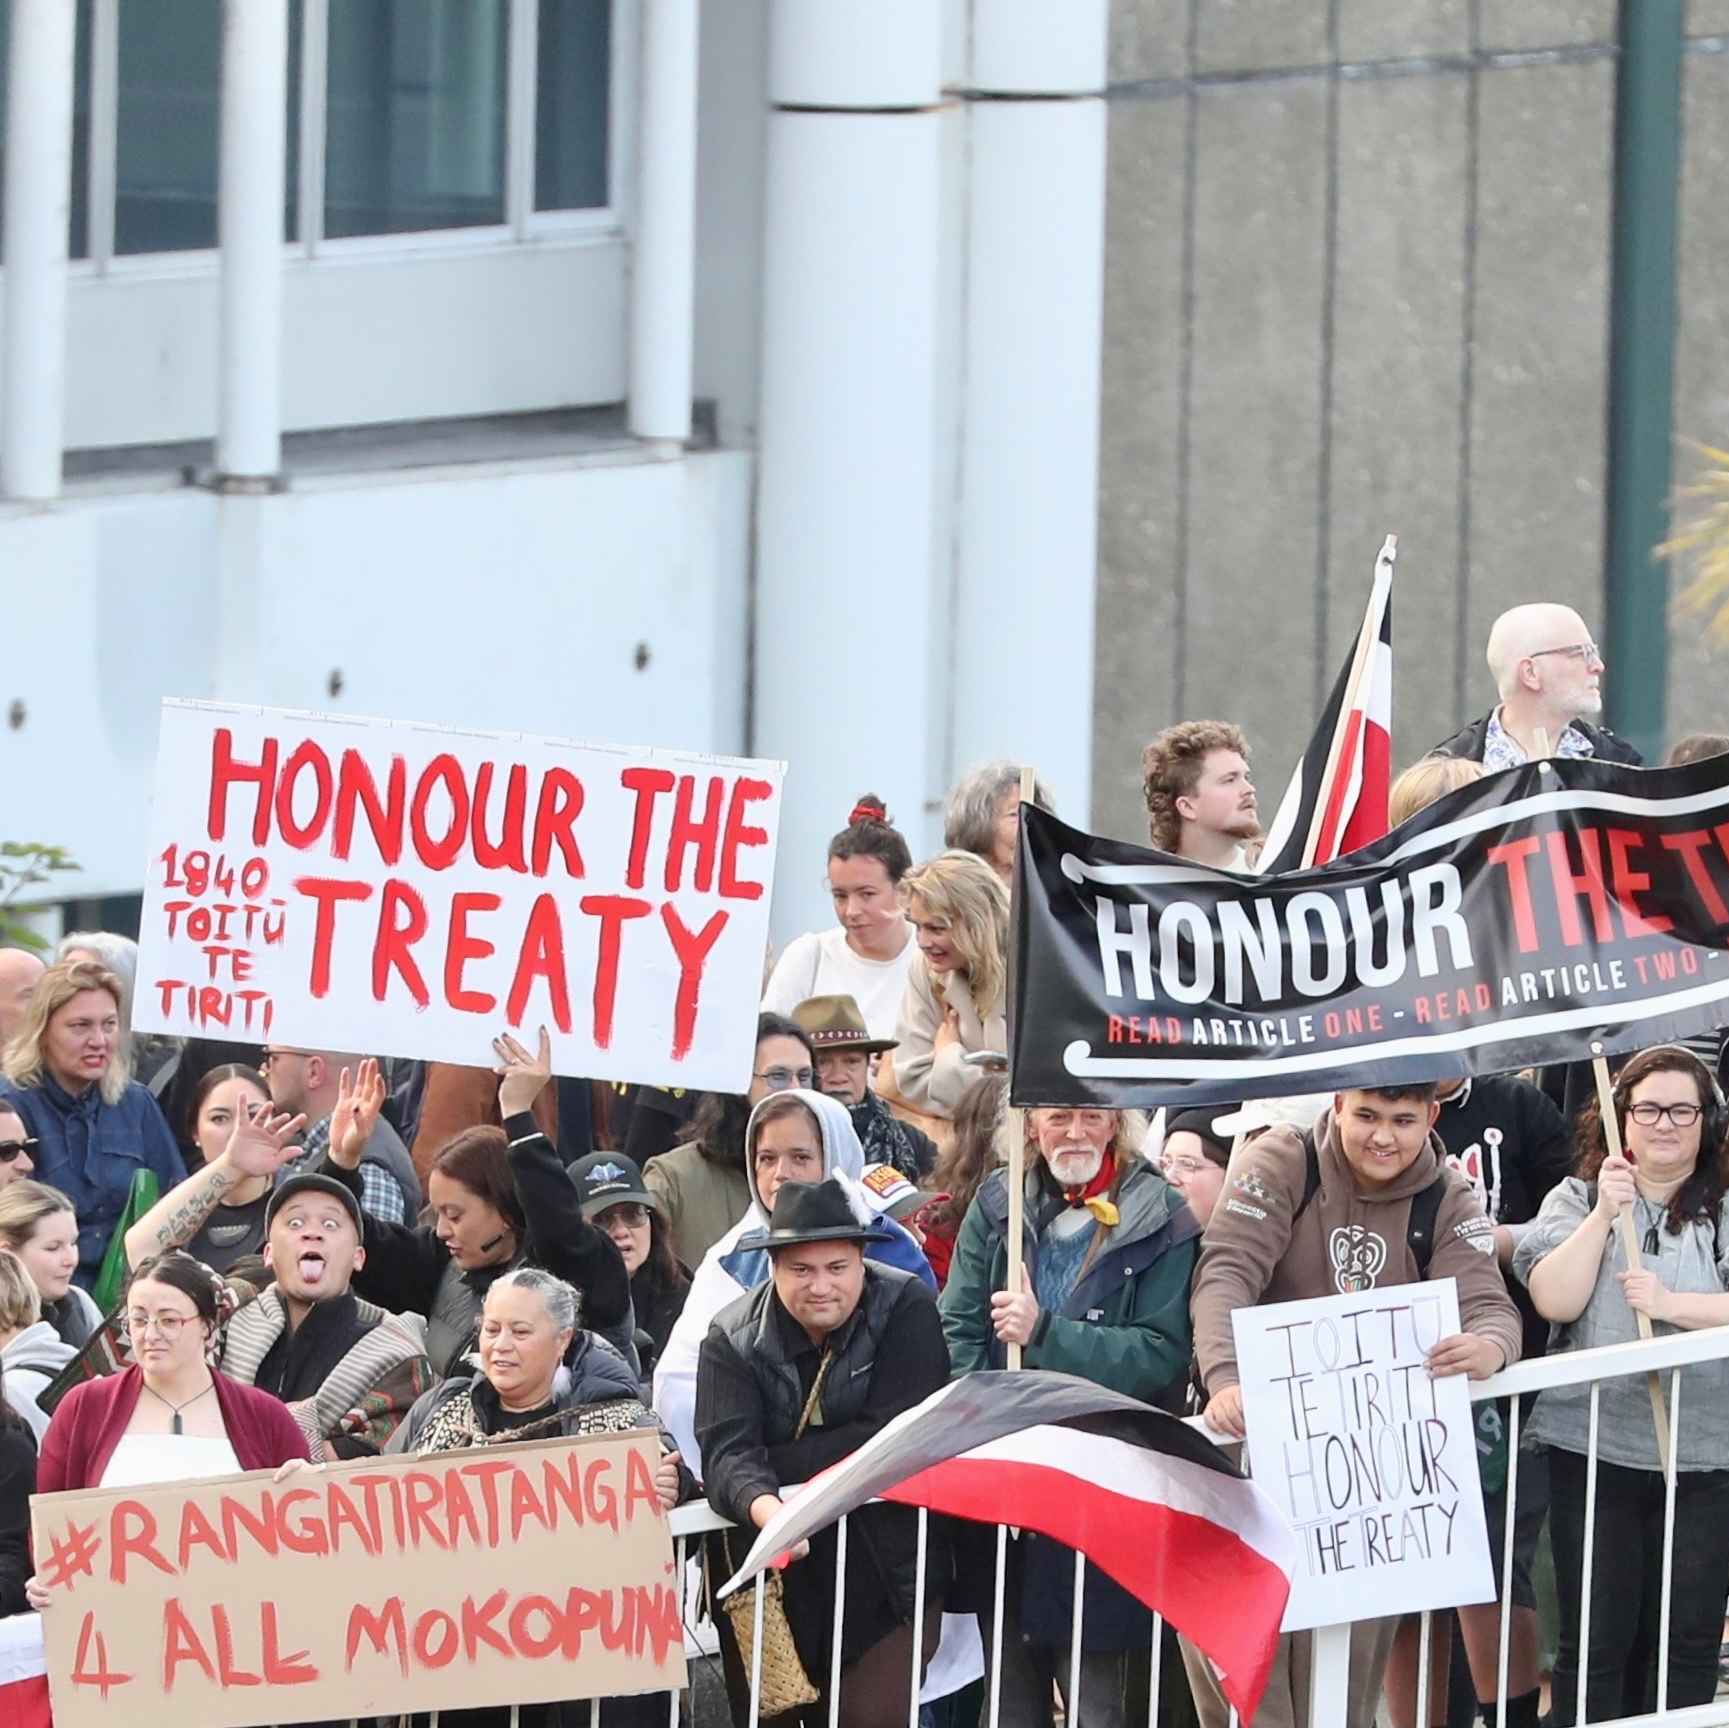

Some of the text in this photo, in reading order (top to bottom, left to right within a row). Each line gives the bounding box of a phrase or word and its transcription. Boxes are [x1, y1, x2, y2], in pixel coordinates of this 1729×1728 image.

[208, 728, 772, 900] HONOUR THE
[161, 843, 270, 899] 1840
[1095, 861, 1474, 1005] HONOUR
[1487, 822, 1676, 955] THE
[202, 946, 256, 981] TE
[295, 877, 730, 1062] TREATY
[1106, 1014, 1182, 1045] READ
[1191, 1013, 1316, 1047] ARTICLE
[1324, 1004, 1383, 1040] ONE
[1415, 983, 1492, 1025] READ
[1500, 960, 1627, 1007] ARTICLE
[1633, 945, 1698, 984] TWO
[1270, 1372, 1329, 1441] TE
[40, 1446, 664, 1591] #RANGATIRATANGA
[1284, 1419, 1459, 1519] HONOUR
[1289, 1500, 1459, 1576] THE TREATY
[70, 1610, 135, 1699] 4
[162, 1598, 319, 1695] ALL
